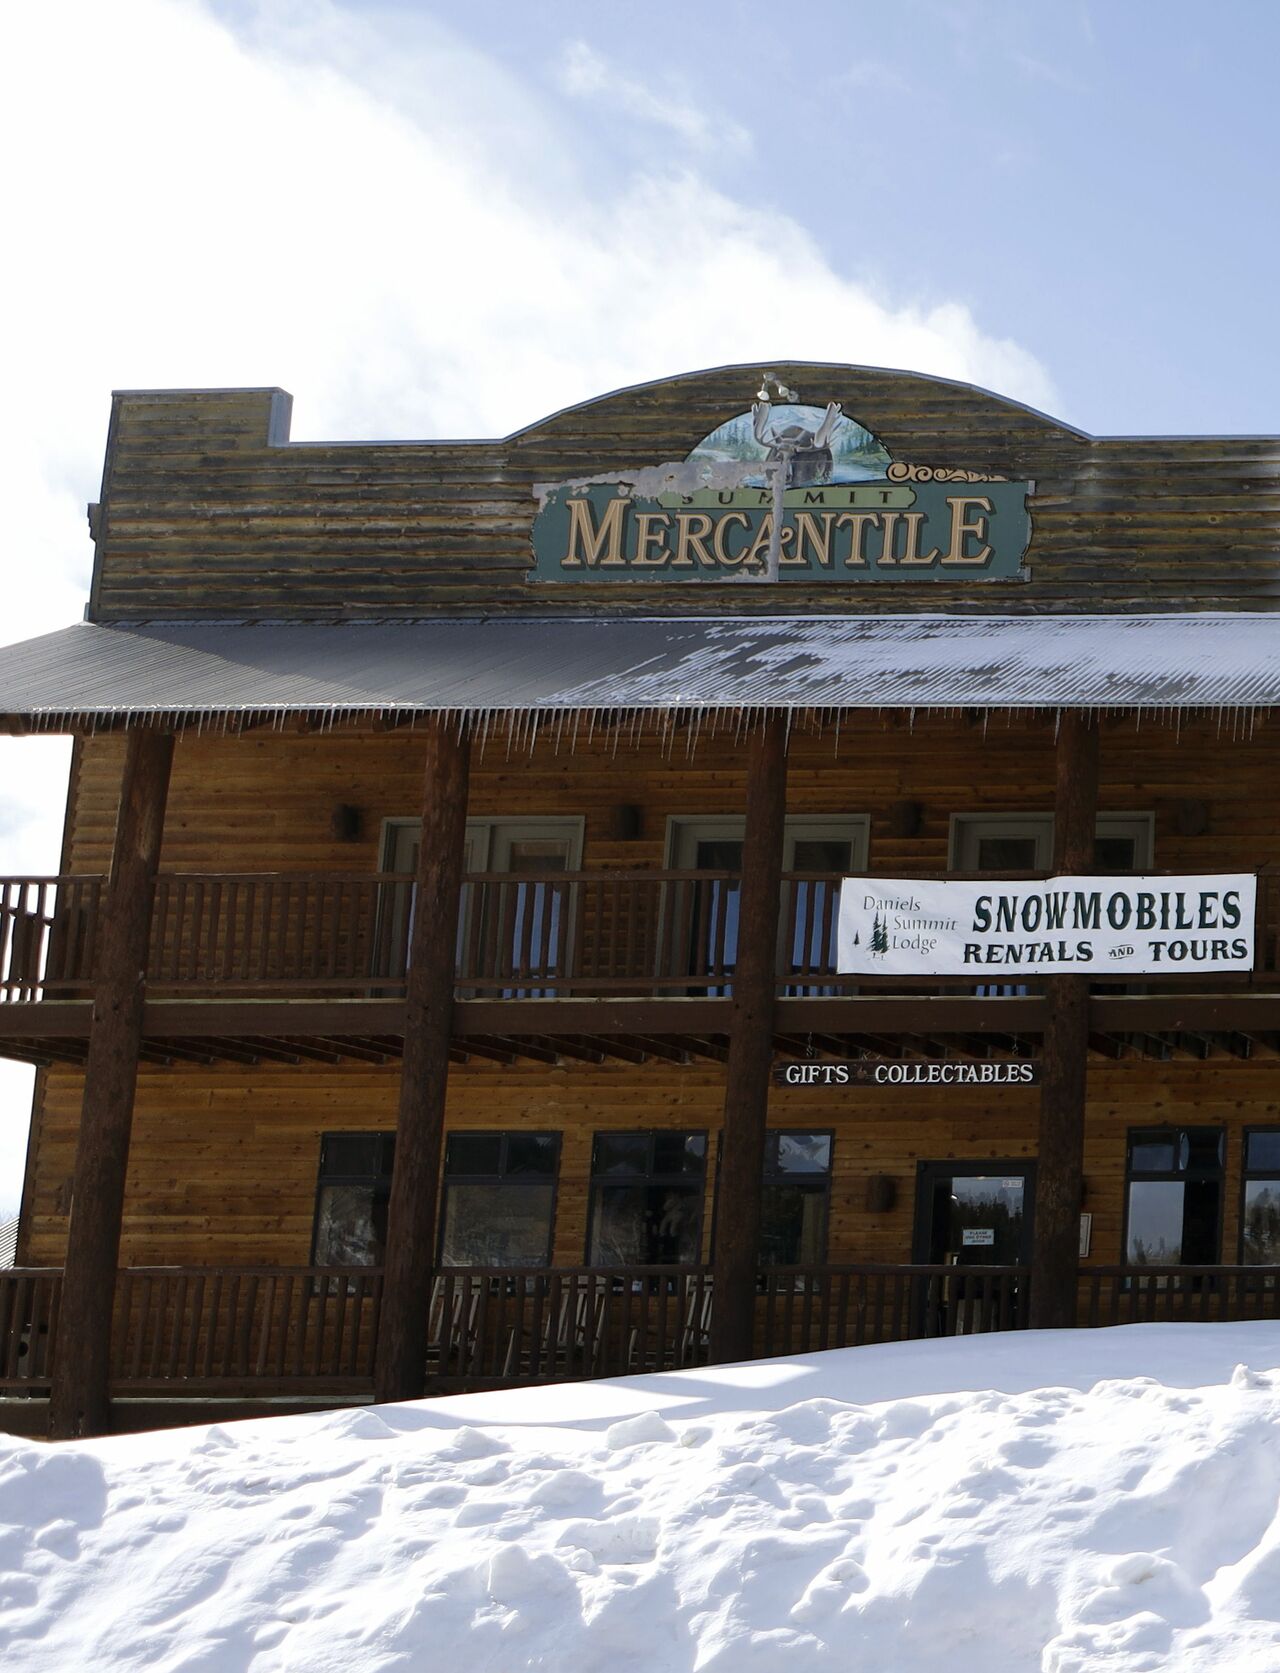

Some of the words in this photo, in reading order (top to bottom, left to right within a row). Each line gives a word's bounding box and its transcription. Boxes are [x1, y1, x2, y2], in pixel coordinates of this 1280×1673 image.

[559, 496, 992, 567] MERCANTILE
[863, 895, 921, 912] Daniels
[972, 891, 1242, 933] SNOWMOBILES
[894, 915, 959, 931] Summit
[892, 934, 938, 955] Lodge
[963, 940, 1094, 964] RENTALS
[1108, 946, 1135, 958] AND
[1148, 938, 1248, 962] TOURS
[785, 1065, 849, 1084] GIFTS
[874, 1064, 1034, 1084] COLLECTABLES
